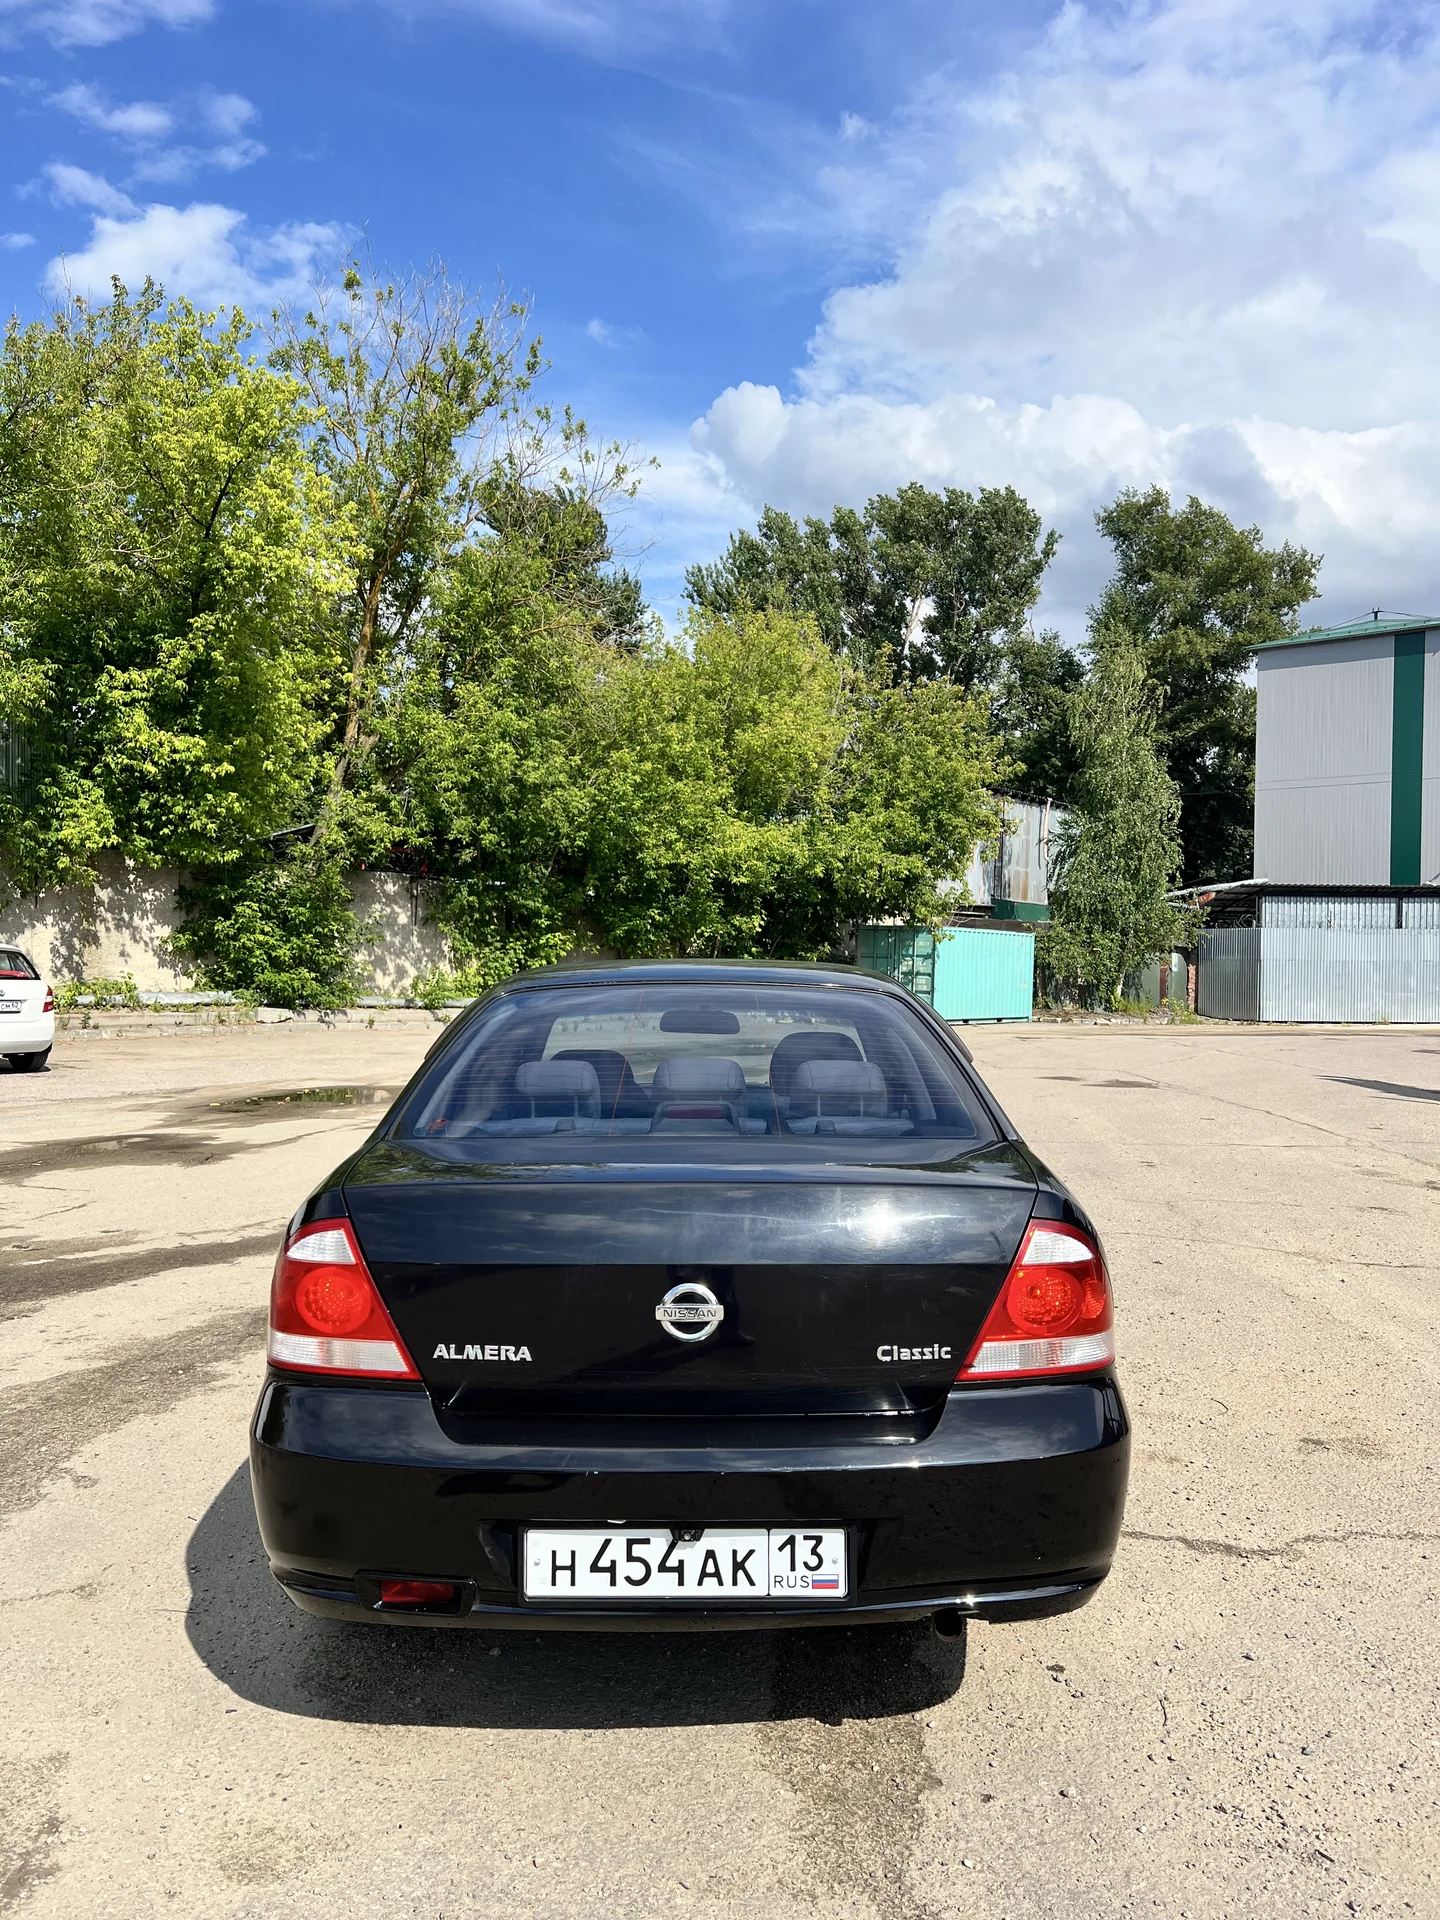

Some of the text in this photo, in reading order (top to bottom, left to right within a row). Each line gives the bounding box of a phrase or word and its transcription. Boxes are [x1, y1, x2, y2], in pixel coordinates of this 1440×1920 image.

[663, 1309, 717, 1318] NISSAN
[433, 1343, 532, 1361] ALMERA
[876, 1343, 952, 1362] Classic
[777, 1535, 824, 1572] 13
[773, 1575, 810, 1589] RUS
